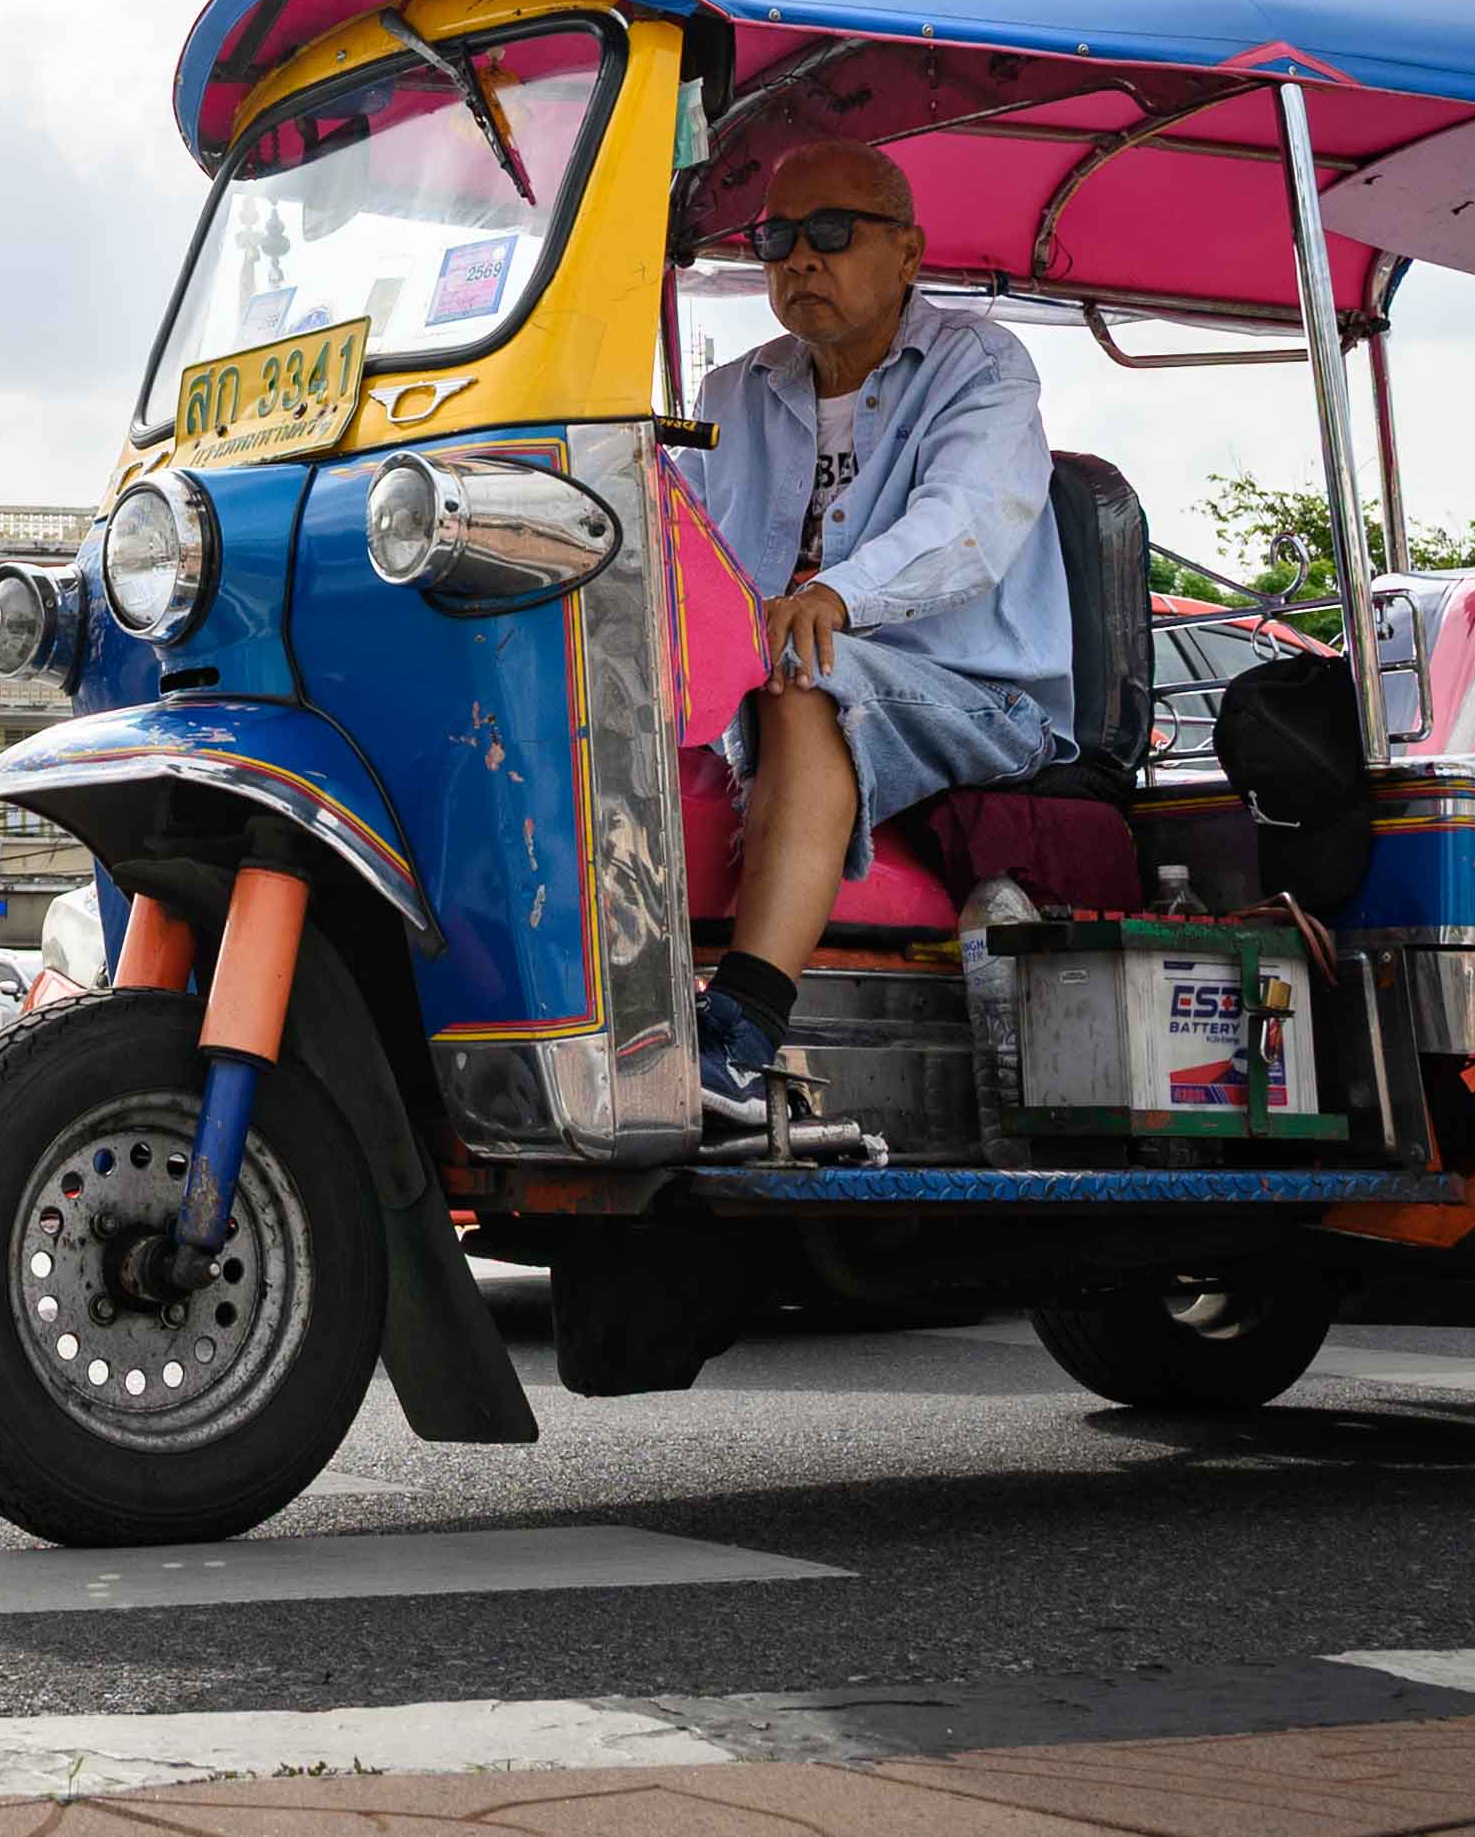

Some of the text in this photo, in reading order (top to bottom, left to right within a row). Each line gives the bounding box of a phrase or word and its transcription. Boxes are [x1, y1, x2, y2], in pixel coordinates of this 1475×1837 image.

[466, 261, 502, 282] 2569
[257, 333, 355, 419] 3341
[1169, 1021, 1241, 1036] BATTERY
